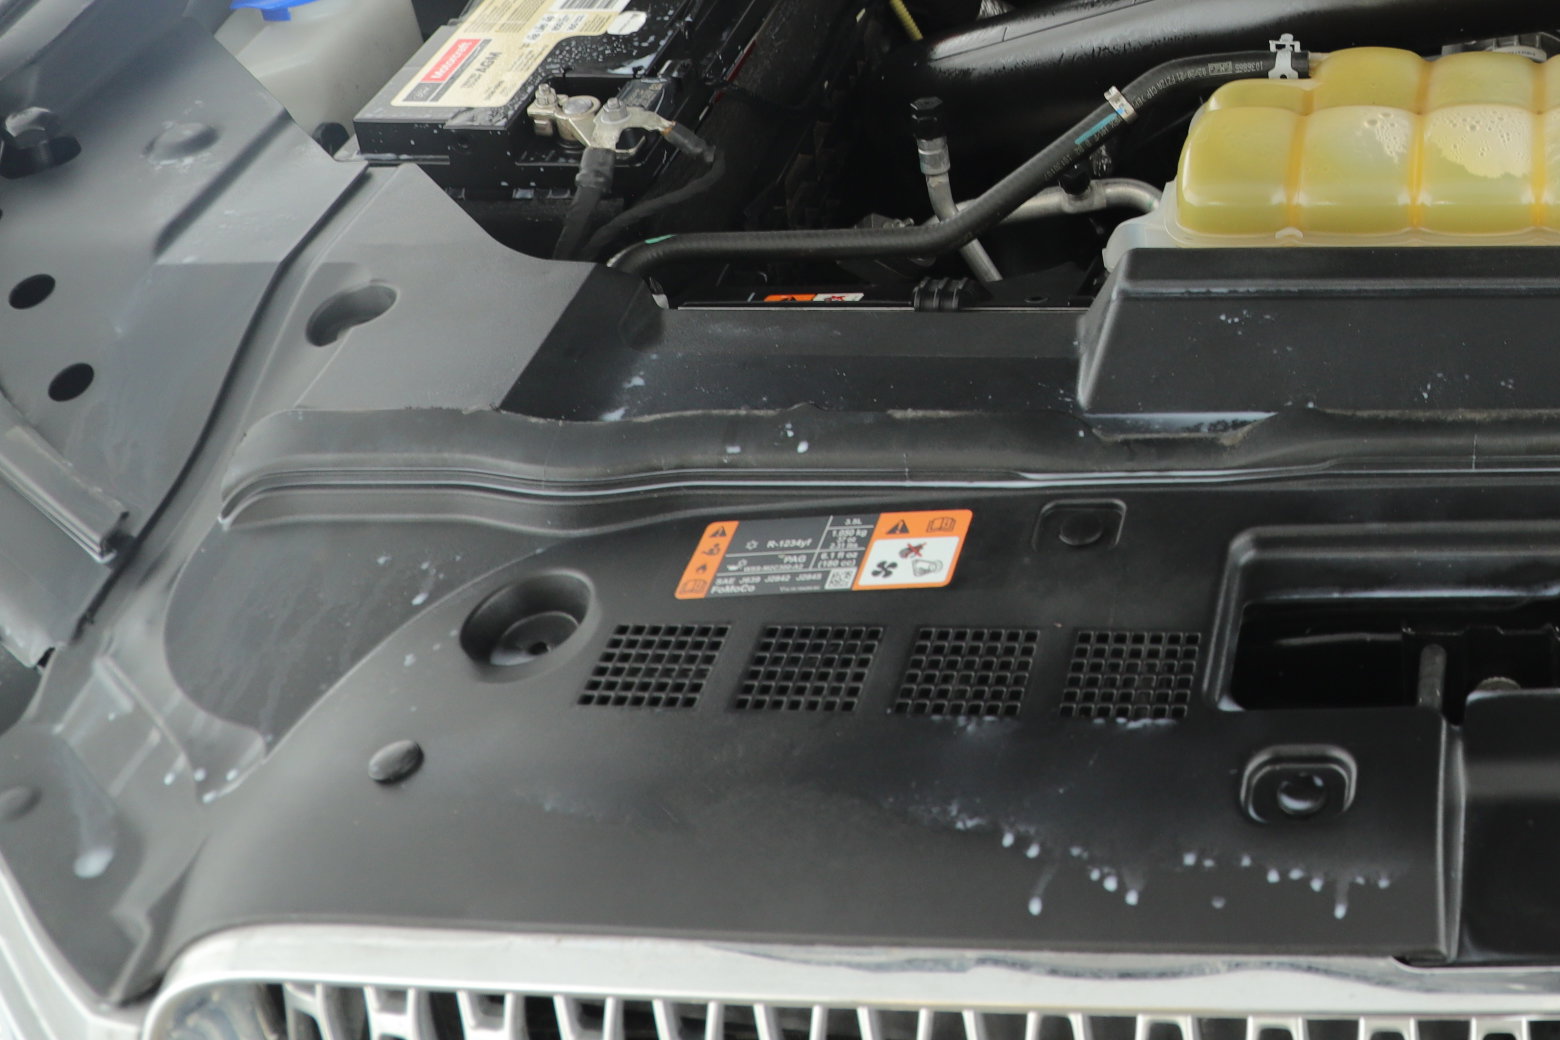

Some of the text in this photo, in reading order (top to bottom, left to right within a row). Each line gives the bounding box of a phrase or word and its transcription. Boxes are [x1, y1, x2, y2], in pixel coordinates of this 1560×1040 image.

[766, 538, 812, 549] R-1234yf
[715, 577, 737, 586] SAE
[710, 584, 756, 595] FoMoCo
